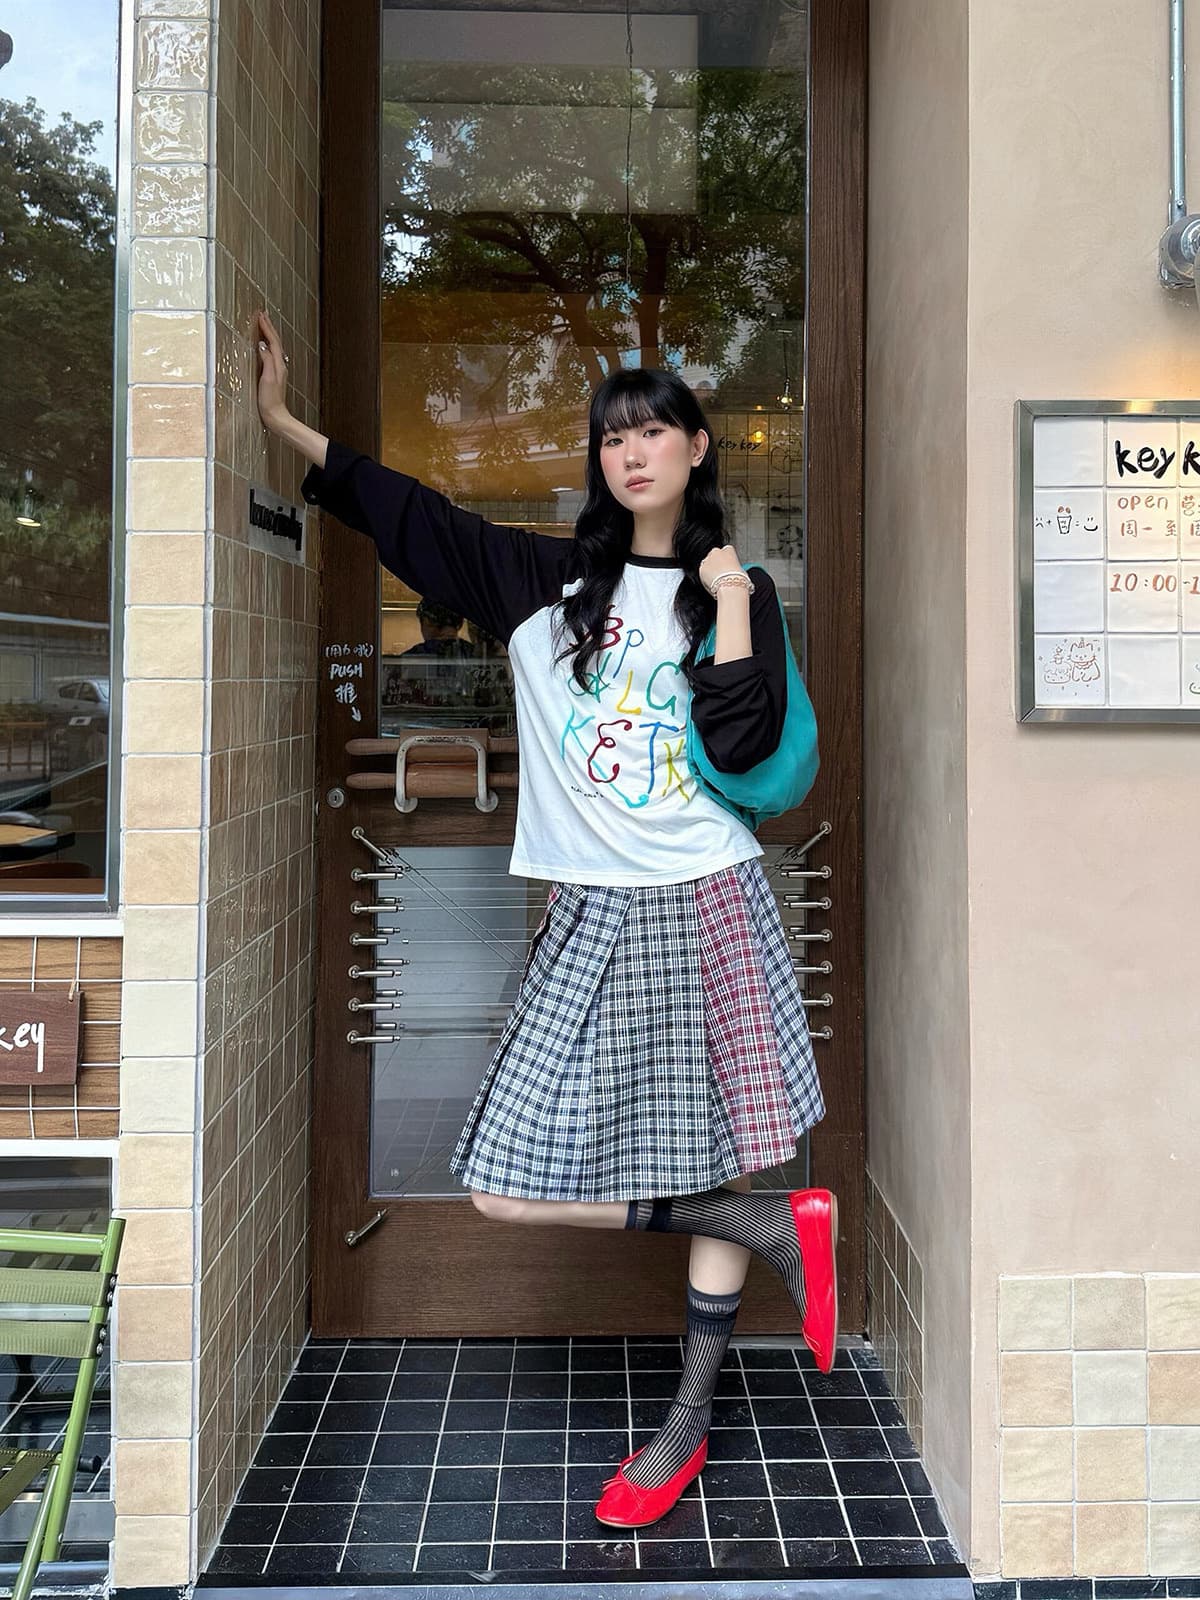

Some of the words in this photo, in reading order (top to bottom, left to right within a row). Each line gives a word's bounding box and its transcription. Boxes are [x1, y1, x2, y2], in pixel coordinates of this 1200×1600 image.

[1114, 439, 1176, 479] key
[1118, 495, 1169, 511] open
[334, 682, 358, 704] 推
